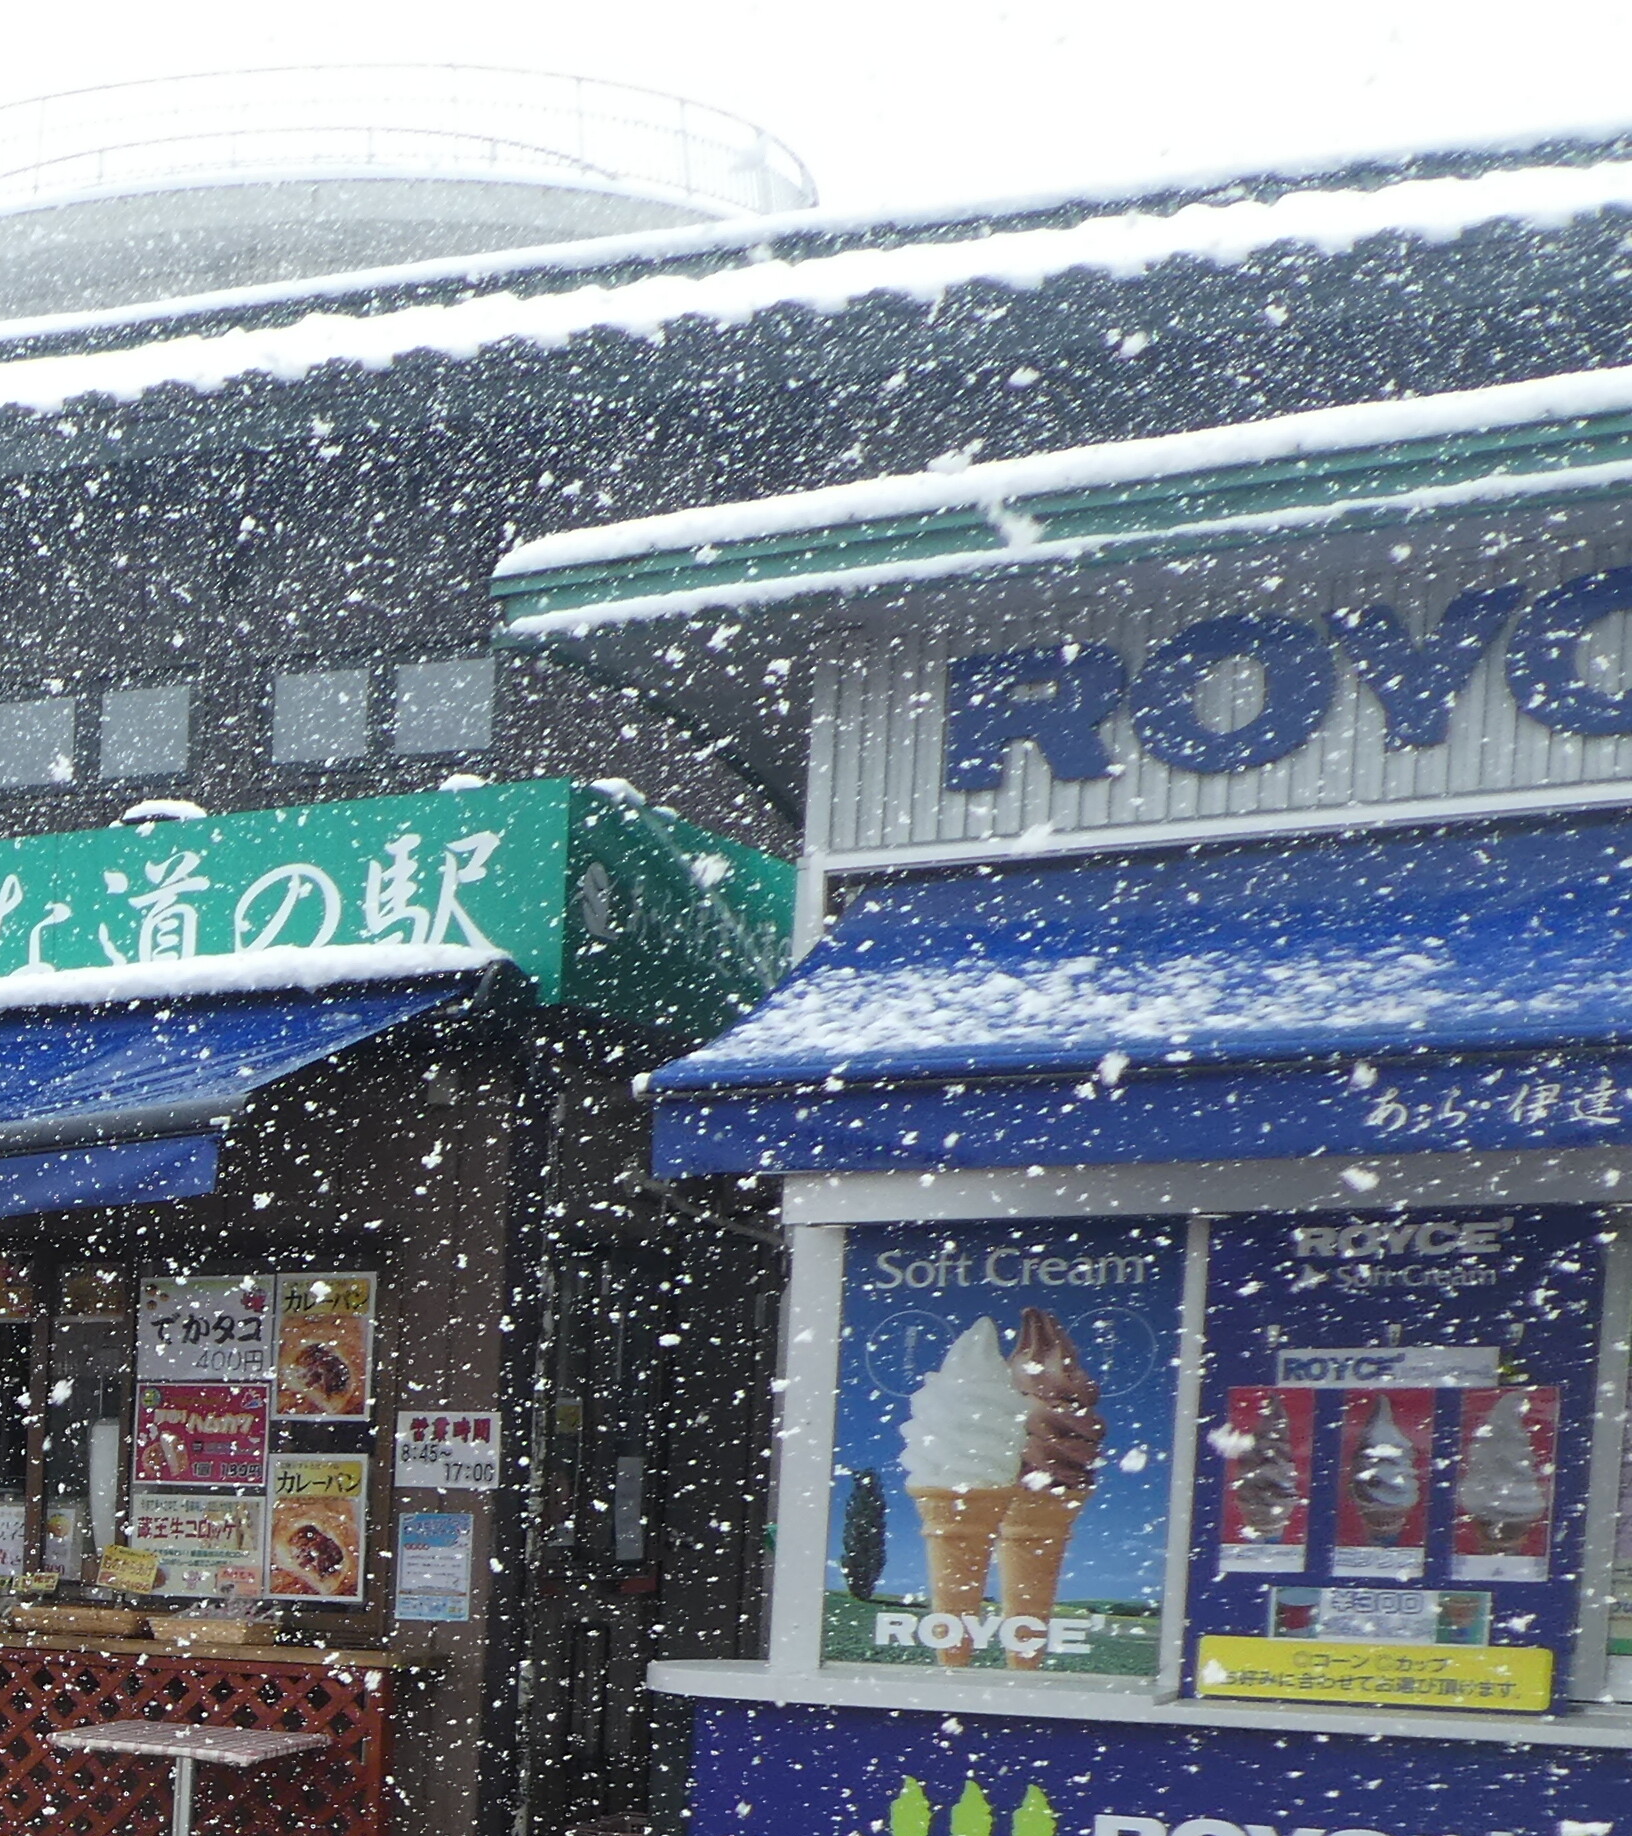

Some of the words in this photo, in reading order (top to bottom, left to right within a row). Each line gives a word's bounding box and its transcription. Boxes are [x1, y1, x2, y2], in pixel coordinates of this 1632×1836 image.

[875, 1248, 973, 1289] Soft
[985, 1248, 1146, 1288] Cream
[1336, 1264, 1393, 1288] Soft
[1401, 1264, 1498, 1287] Cream
[150, 1312, 263, 1345] でかタコ
[195, 1350, 264, 1372] 400円
[410, 1416, 491, 1444] 営業時間
[276, 1470, 361, 1494] カレーパン
[443, 1462, 495, 1482] 17:00
[874, 1612, 1106, 1654] ROYCE'
